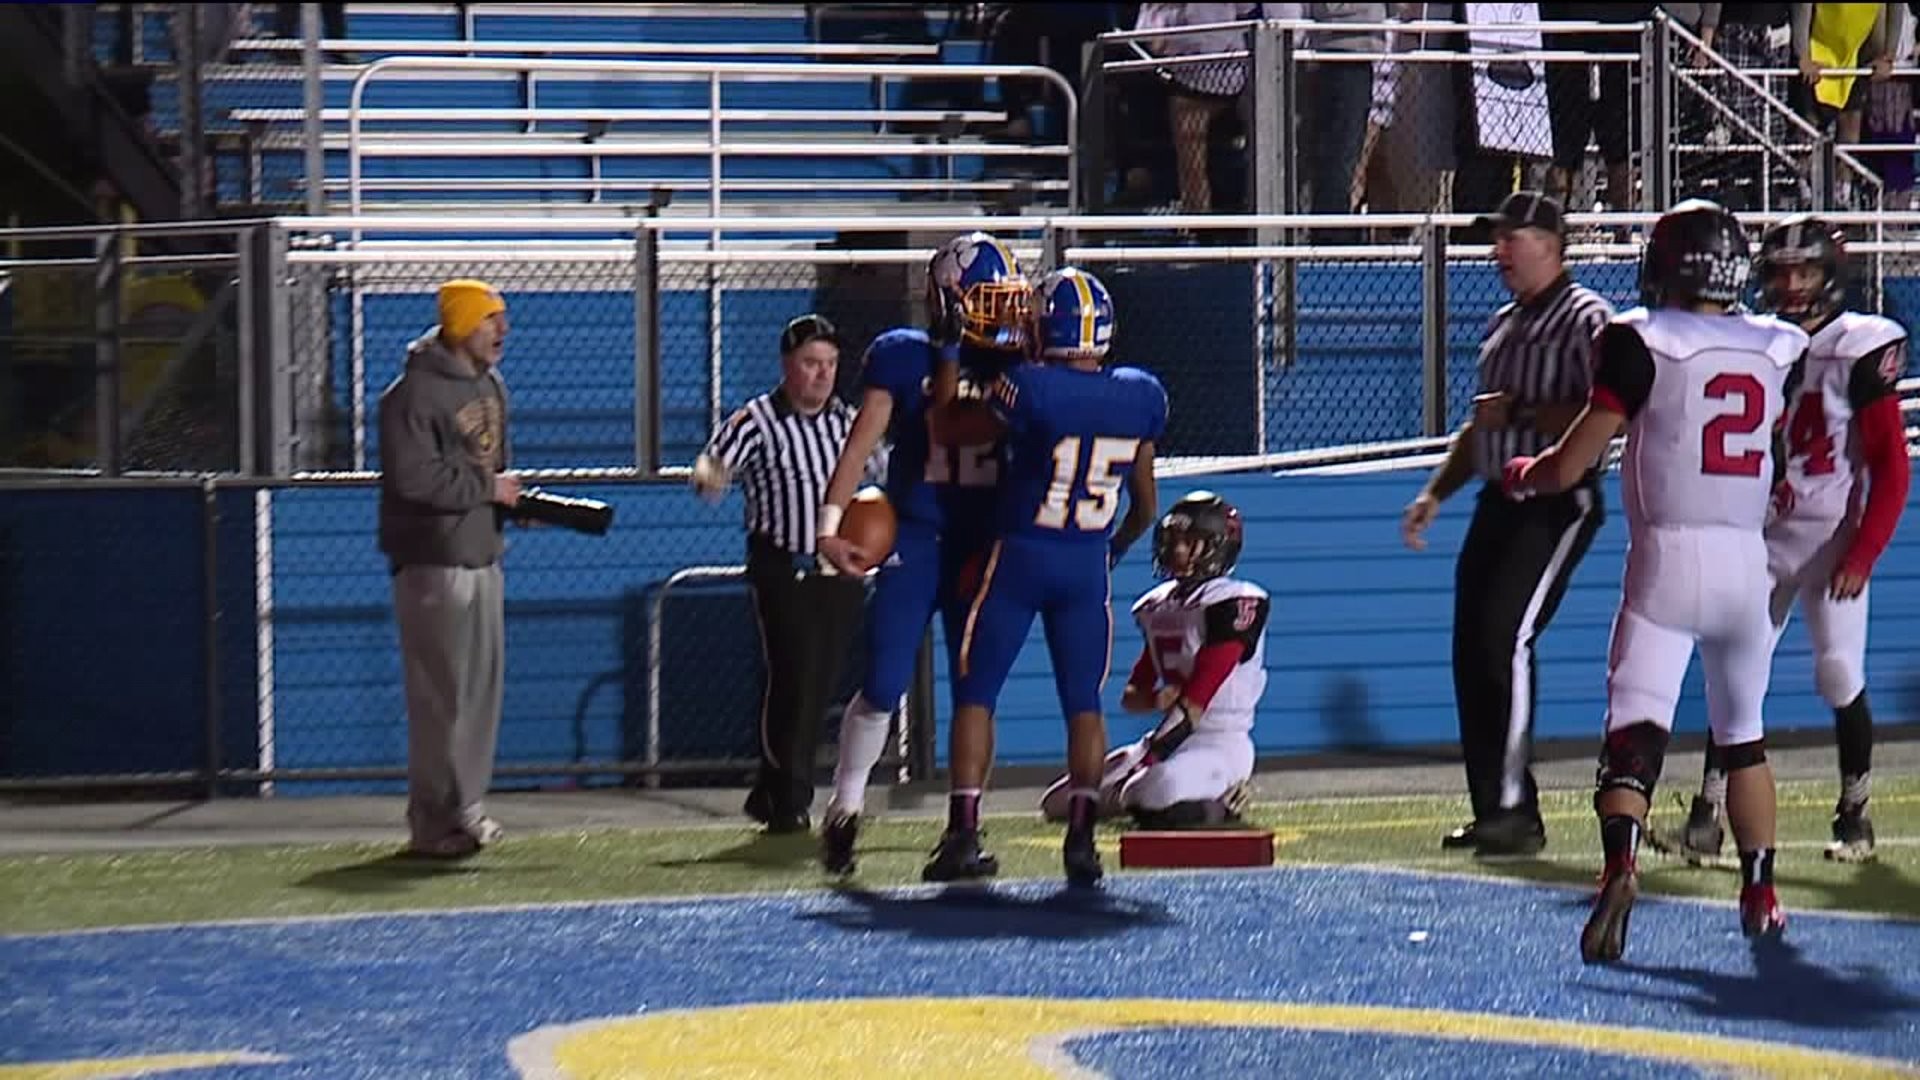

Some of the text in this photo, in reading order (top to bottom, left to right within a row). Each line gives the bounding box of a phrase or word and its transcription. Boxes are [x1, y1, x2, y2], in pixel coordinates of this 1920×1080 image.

[1701, 372, 1766, 478] 2
[1788, 391, 1836, 476] 4
[1034, 436, 1142, 532] 15
